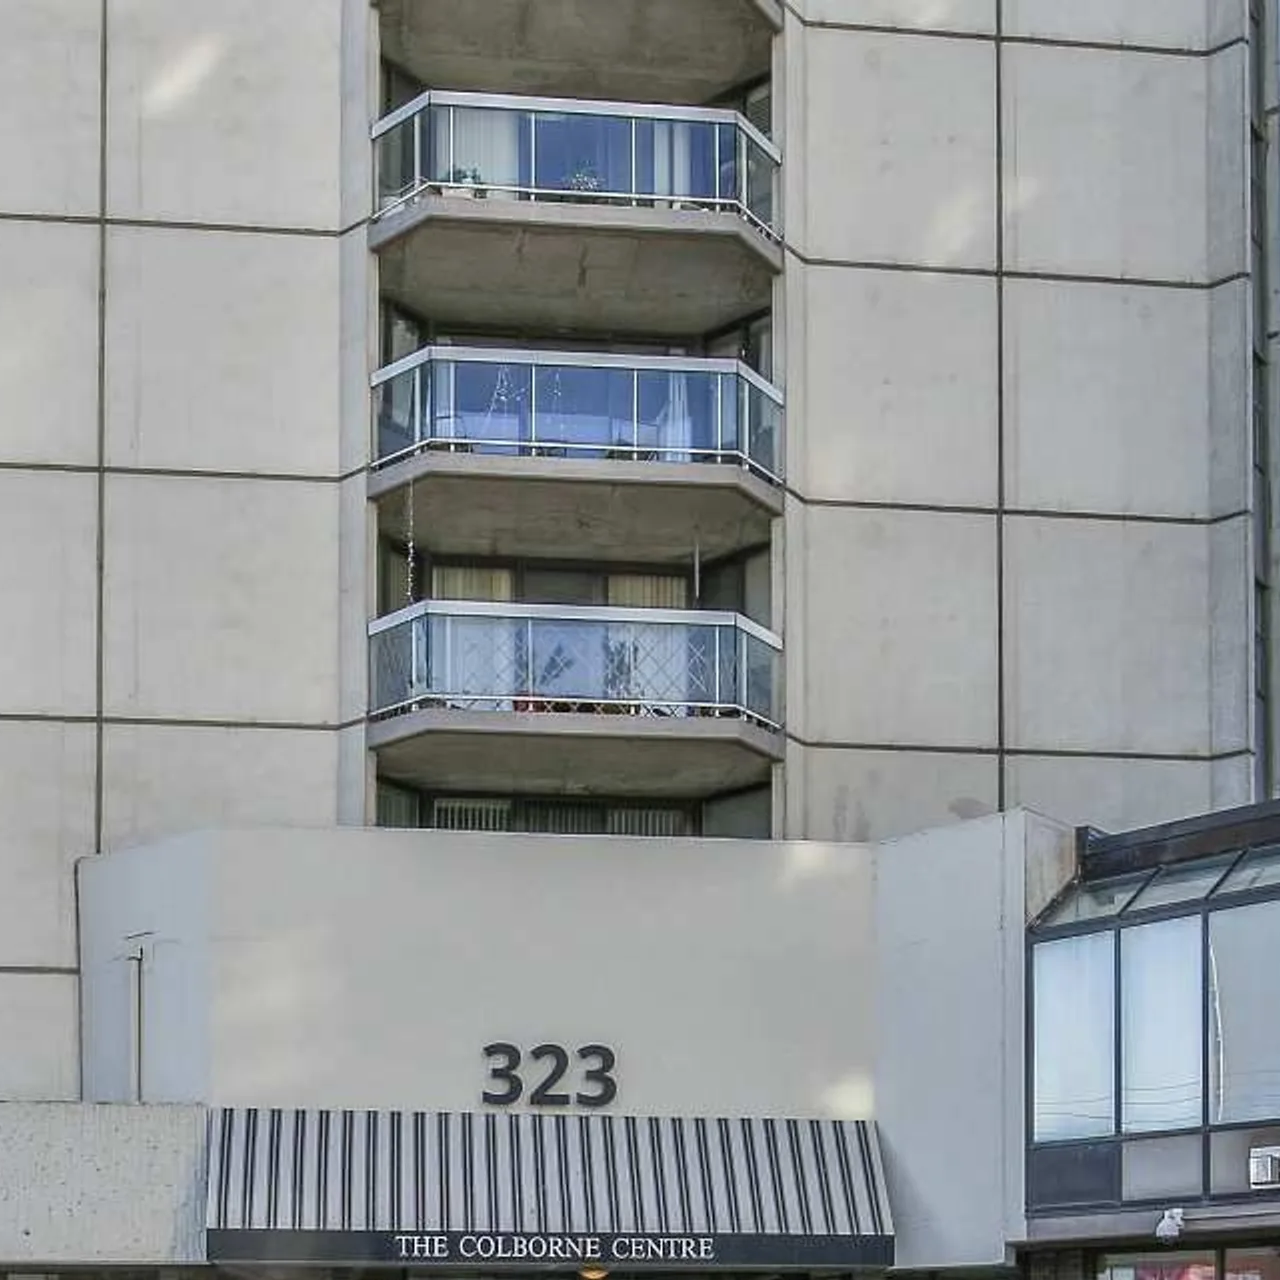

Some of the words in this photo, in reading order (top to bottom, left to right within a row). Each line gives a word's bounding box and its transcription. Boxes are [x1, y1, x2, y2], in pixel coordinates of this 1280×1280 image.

[481, 1042, 618, 1107] 323
[395, 1235, 449, 1258] THE
[459, 1235, 601, 1259] COLBORNE
[611, 1237, 715, 1260] CENTRE
